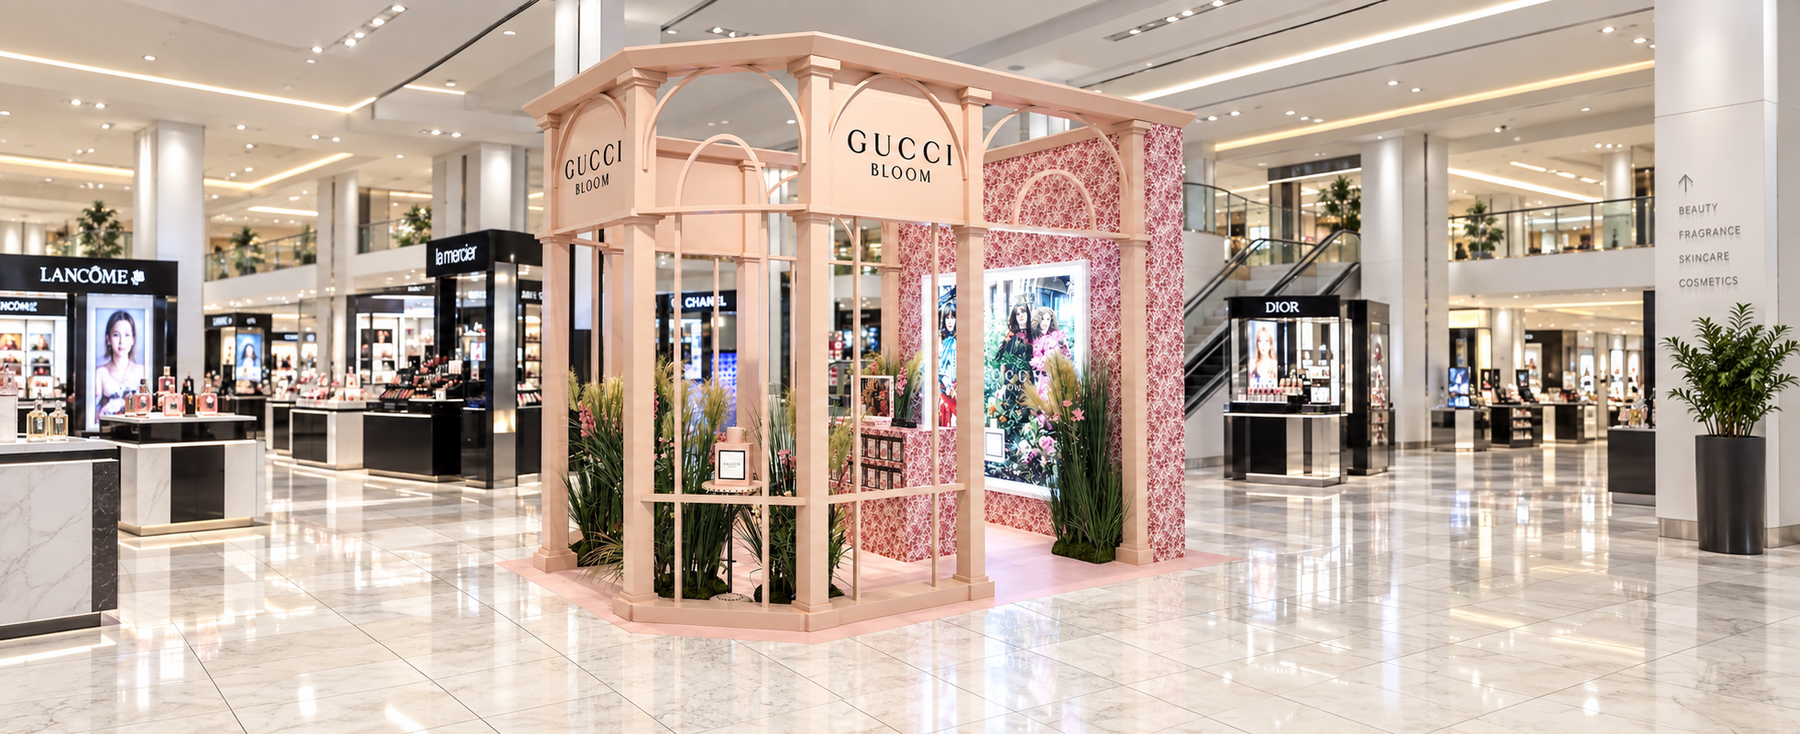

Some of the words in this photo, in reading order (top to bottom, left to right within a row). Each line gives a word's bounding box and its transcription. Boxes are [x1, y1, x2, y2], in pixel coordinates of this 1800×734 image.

[847, 129, 952, 166] GUCCI
[565, 140, 622, 180] GUCCI
[871, 162, 931, 183] BLOOM
[575, 173, 609, 195] BLOOM
[1679, 203, 1718, 215] BEAUTY
[1679, 225, 1741, 239] FRAGRANCE
[1679, 251, 1729, 264] SKINCARE
[40, 265, 128, 285] LANCÔME
[1679, 276, 1738, 288] COSMETICS
[1265, 301, 1300, 313] DIOR
